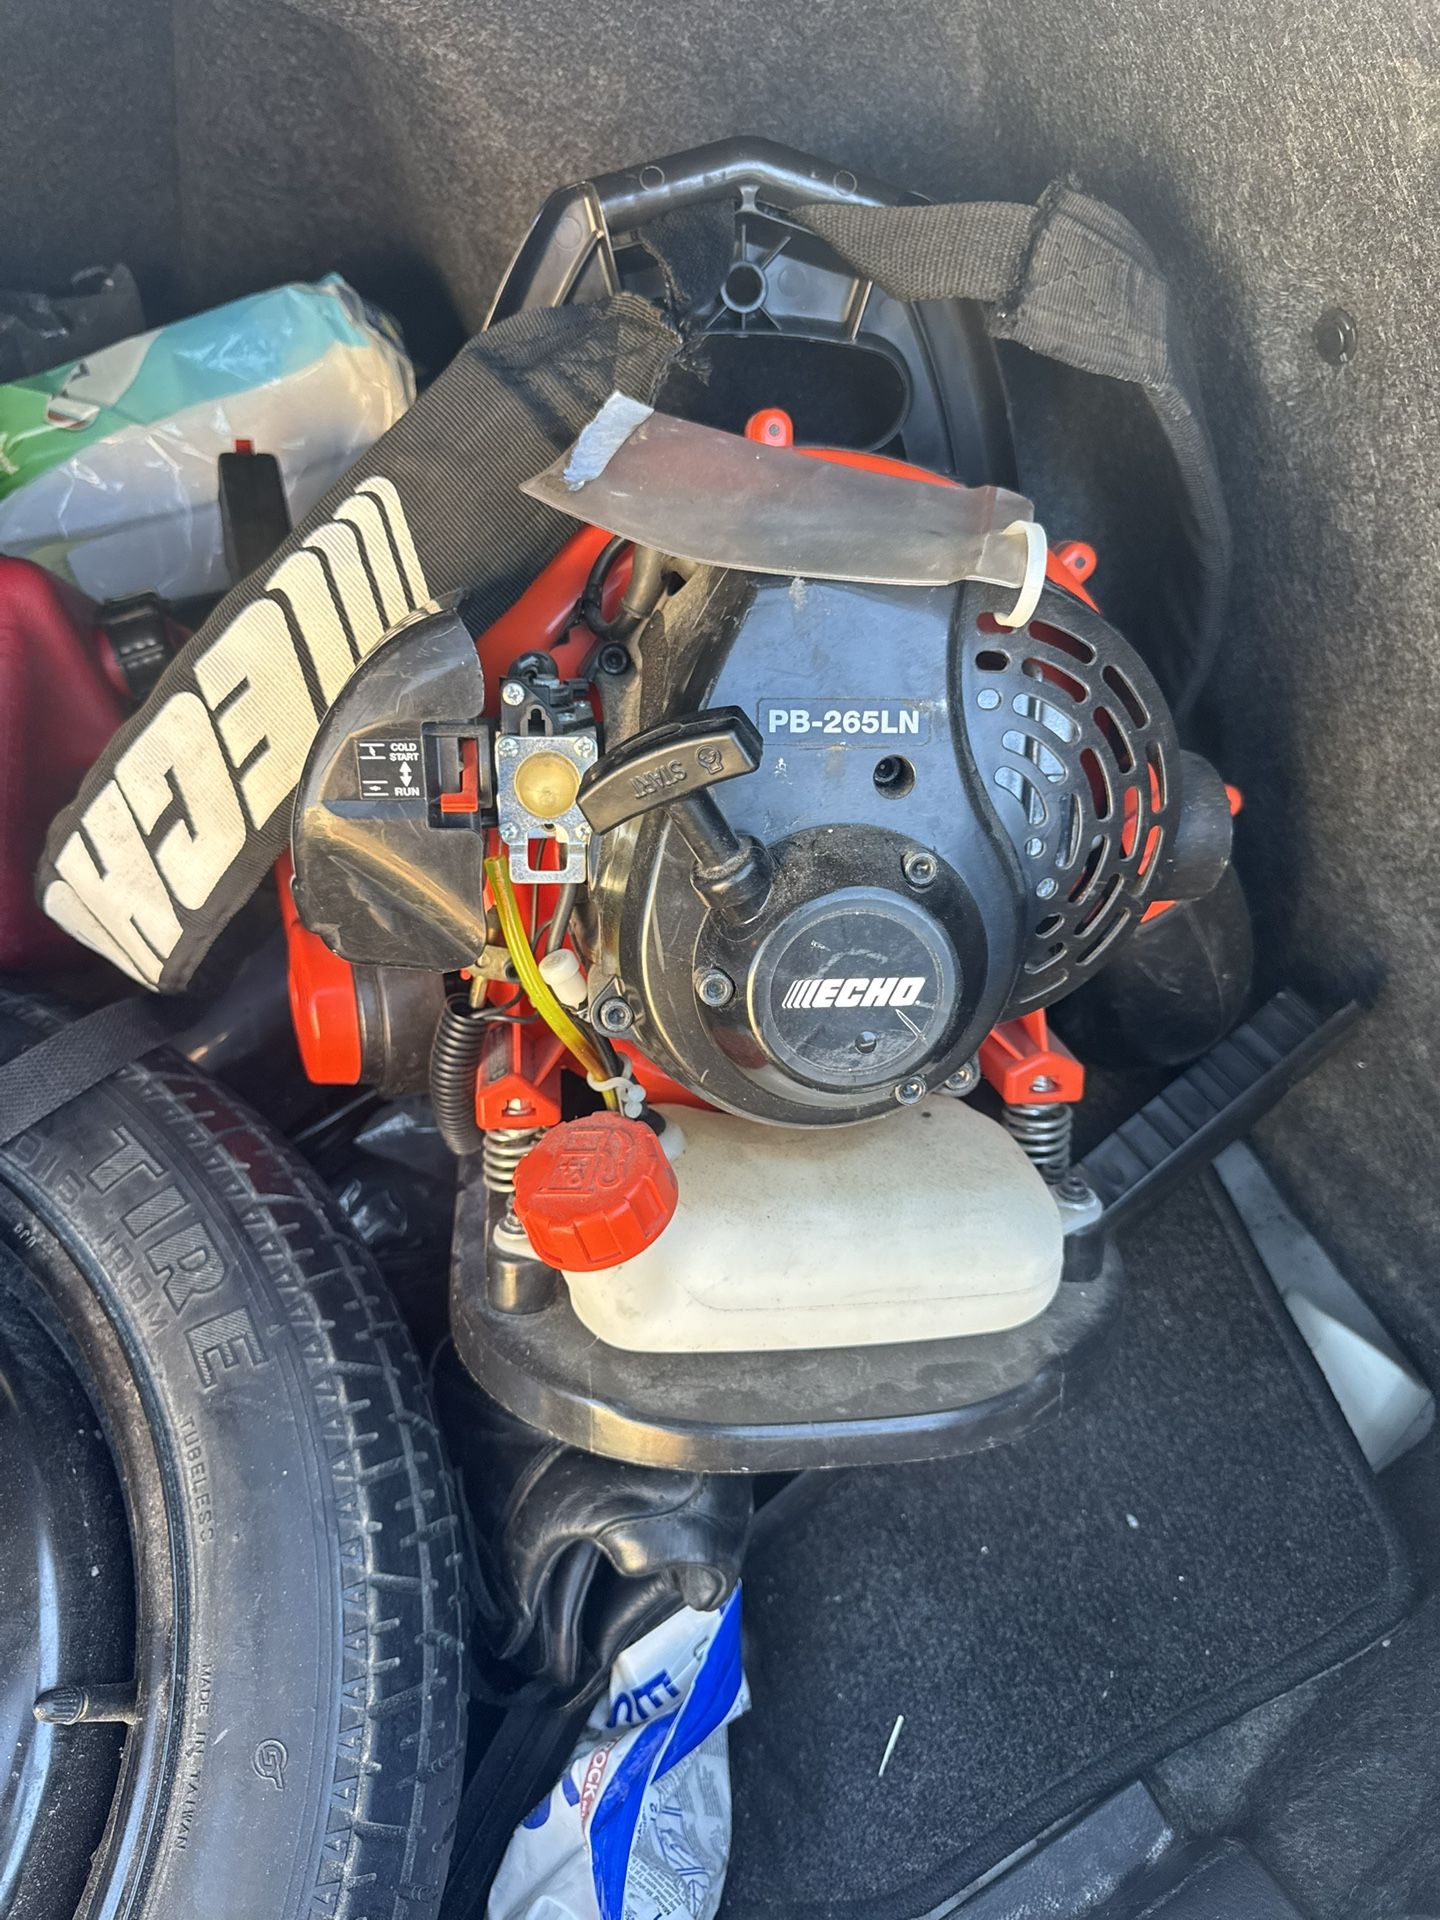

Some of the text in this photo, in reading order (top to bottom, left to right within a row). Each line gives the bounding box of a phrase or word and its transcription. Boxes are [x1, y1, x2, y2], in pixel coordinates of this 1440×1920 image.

[768, 709, 920, 734] PB-265LN
[389, 752, 420, 762] START
[390, 742, 417, 752] COLD
[394, 786, 421, 797] RUN
[629, 759, 687, 799] START
[811, 977, 926, 1008] ECHO
[84, 1126, 270, 1389] TIRE
[180, 1416, 214, 1543] TUBELESS
[175, 1663, 213, 1850] MADE IN TAIWAN
